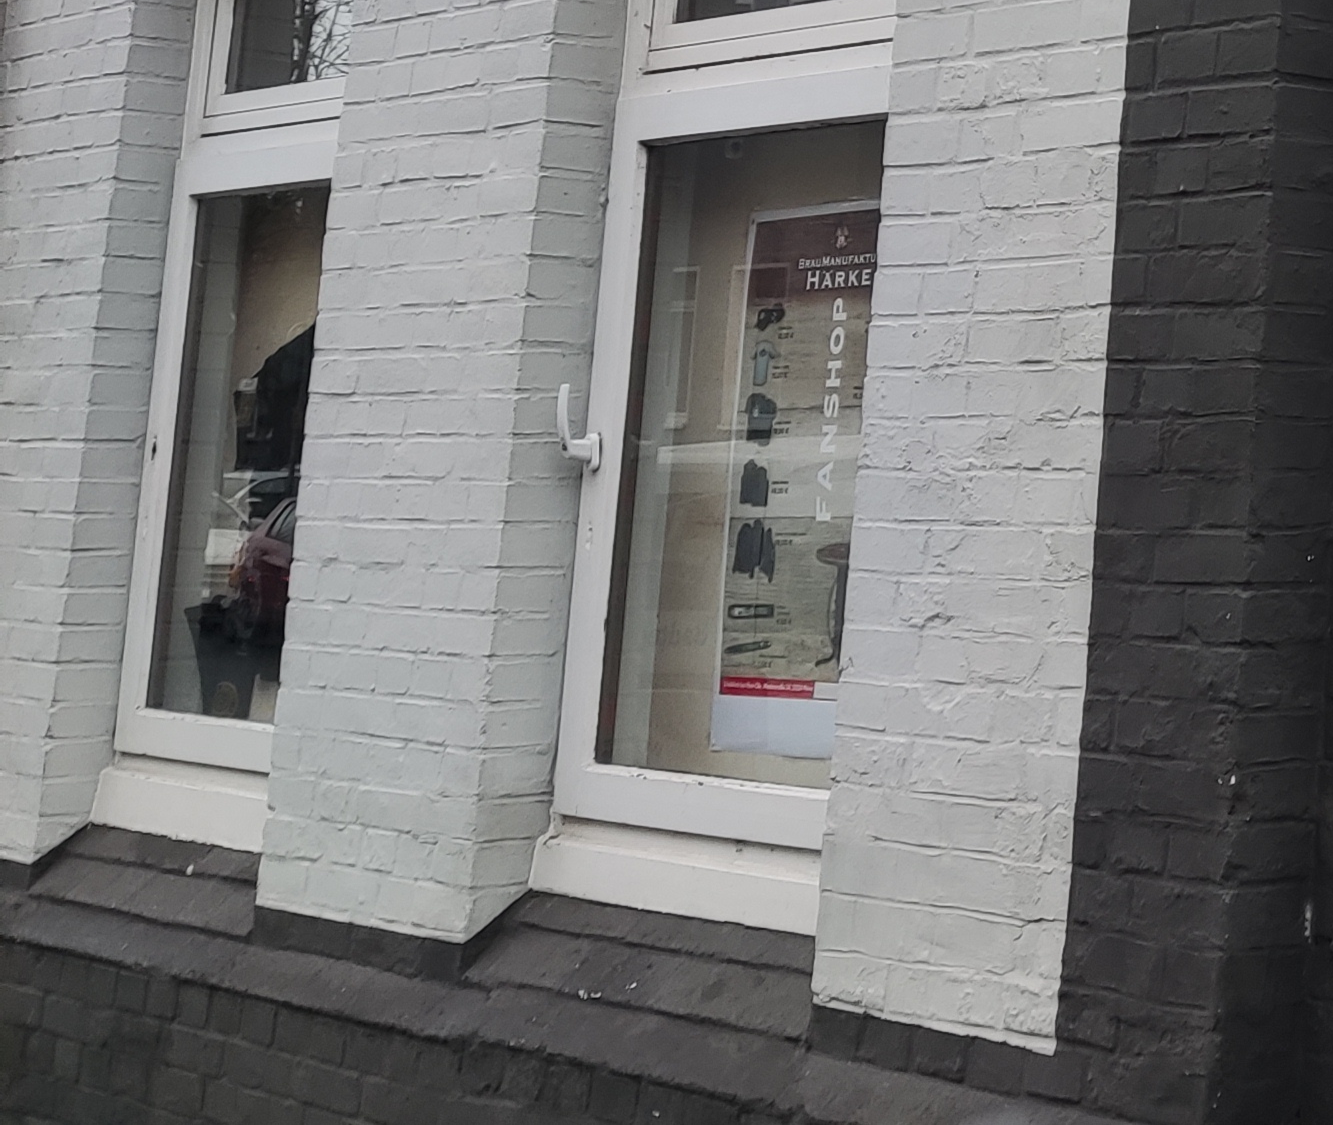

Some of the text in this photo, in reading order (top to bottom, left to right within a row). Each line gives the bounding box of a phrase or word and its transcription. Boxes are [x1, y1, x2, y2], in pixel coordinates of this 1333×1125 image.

[798, 254, 876, 269] BRAUMANUFAKTU
[805, 268, 872, 290] HÄRKE
[815, 298, 847, 522] FANSHOP
